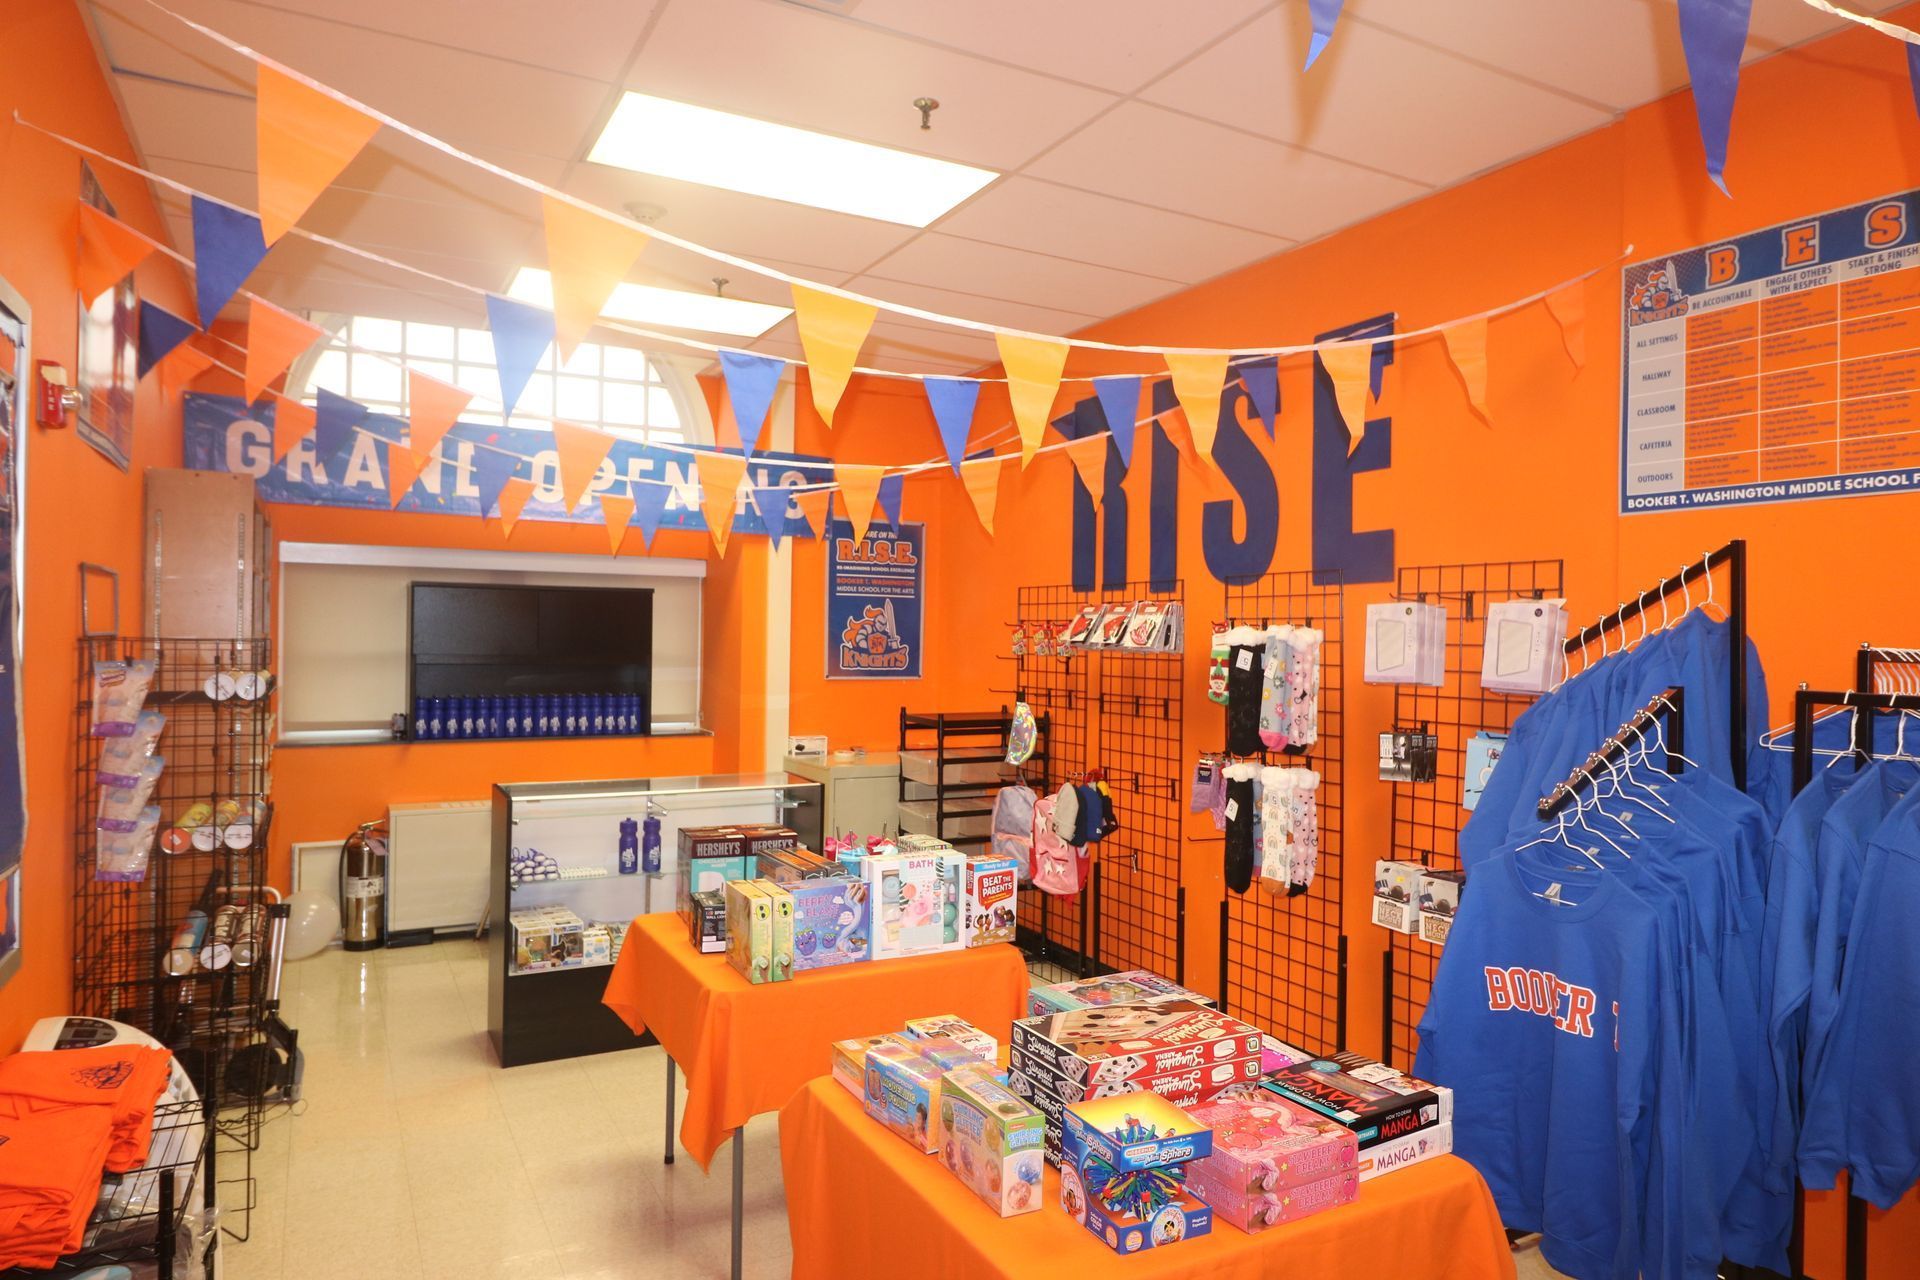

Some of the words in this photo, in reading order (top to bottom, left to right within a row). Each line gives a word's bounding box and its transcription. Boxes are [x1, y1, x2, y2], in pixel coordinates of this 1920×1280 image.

[1706, 244, 1739, 289] B
[1782, 221, 1820, 270] E
[1864, 202, 1907, 248] S
[1848, 256, 1874, 270] START
[1878, 253, 1884, 262] &
[1888, 247, 1919, 260] FINISH
[1864, 260, 1902, 276] STRONG
[1766, 272, 1797, 288] ENGAGE
[1800, 266, 1833, 280] OTHERS
[1770, 284, 1791, 296] WITH
[1793, 276, 1828, 291] RESPECT
[1692, 300, 1701, 310] BE
[1702, 289, 1752, 308] ACCOUNTABLE
[1636, 338, 1650, 348] ALL
[1654, 333, 1678, 346] SETTINGS
[1642, 370, 1672, 382] HALLWAY
[1638, 404, 1676, 417] CLASSROOM
[1072, 312, 1394, 593] RISE
[1640, 440, 1672, 451] CAFETERIA
[1638, 472, 1673, 484] OUTDOORS
[1628, 496, 1676, 509] BOOKER
[1680, 494, 1690, 505] T.
[1693, 486, 1786, 503] WASHINGTON
[1788, 480, 1841, 495] MIDDLE
[1844, 474, 1910, 490] SCHOOL
[836, 538, 917, 566] R.I.S.E.
[842, 646, 908, 668] KNIGHTS
[697, 842, 740, 856] HERSHEY'S
[752, 839, 793, 854] HERSHEY'S
[909, 859, 933, 869] BATH
[982, 876, 1002, 887] BEAT
[982, 883, 1012, 897] PARENTS
[1163, 1011, 1232, 1045] Slingshot
[1156, 1046, 1204, 1073] Slingshot
[1276, 1081, 1303, 1094] DRAW
[1276, 1070, 1378, 1112] MANGA
[1301, 1091, 1315, 1099] TO
[1316, 1098, 1341, 1110] HOW
[1381, 1113, 1418, 1139] MANGA
[1008, 1127, 1043, 1142] SWIRLING
[1087, 1135, 1112, 1162] Sphere
[1161, 1148, 1192, 1163] Sphere
[1377, 1146, 1416, 1171] MANGA
